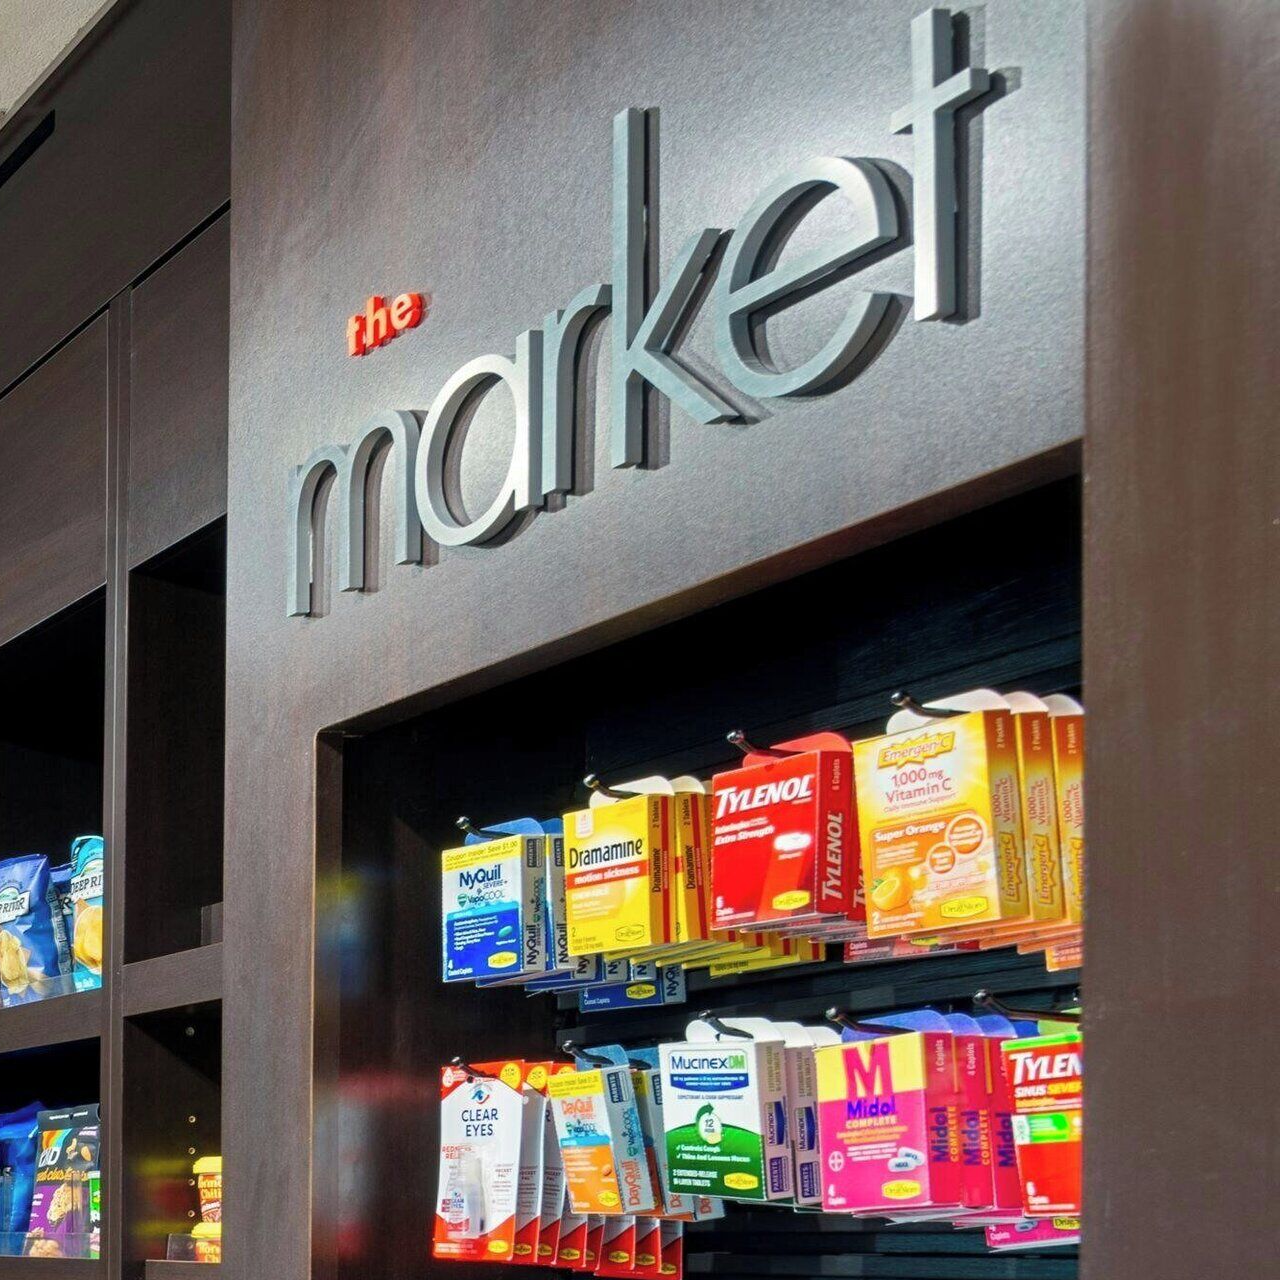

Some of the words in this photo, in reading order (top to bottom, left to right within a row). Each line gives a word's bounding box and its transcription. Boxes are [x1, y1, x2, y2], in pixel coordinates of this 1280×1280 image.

[286, 6, 992, 618] market
[345, 290, 428, 357] the
[881, 733, 951, 764] Emergen-C
[885, 783, 941, 803] Vitamin
[942, 778, 953, 792] C
[891, 767, 928, 788] 1,000
[928, 769, 945, 782] mg
[715, 774, 815, 820] TYLENOL
[1002, 787, 1011, 825] Vitamin
[874, 828, 906, 843] Super
[905, 821, 948, 838] Orange
[569, 838, 643, 868] Dramamine
[686, 844, 696, 890] Dramamine
[821, 812, 843, 900] TYLENOL
[459, 864, 502, 889] NyQuil
[574, 871, 600, 885] motion
[602, 865, 640, 880] sickness
[651, 847, 662, 893] Dramamine
[3, 897, 26, 915] RIVER
[872, 911, 882, 925] 2
[526, 924, 538, 966] NyQuil
[936, 1039, 944, 1064] Caplets
[967, 1042, 975, 1068] Caplets
[842, 1041, 895, 1098] M
[1009, 1052, 1082, 1085] TYLEN
[1015, 1084, 1047, 1097] SINUS
[461, 1108, 499, 1122] CLEAR
[560, 1098, 595, 1116] DayQuil
[845, 1115, 897, 1128] COMPLETE
[846, 1097, 896, 1119] Midol
[465, 1124, 494, 1137] EYES
[704, 1118, 715, 1128] 12
[930, 1106, 948, 1162] Midol
[948, 1106, 958, 1162] COMPLETE
[963, 1110, 980, 1166] Midol
[981, 1109, 989, 1166] COMPLETE
[620, 1159, 641, 1206] DayQuil
[771, 1161, 780, 1192] PARENTS
[802, 1166, 810, 1196] PARENTS
